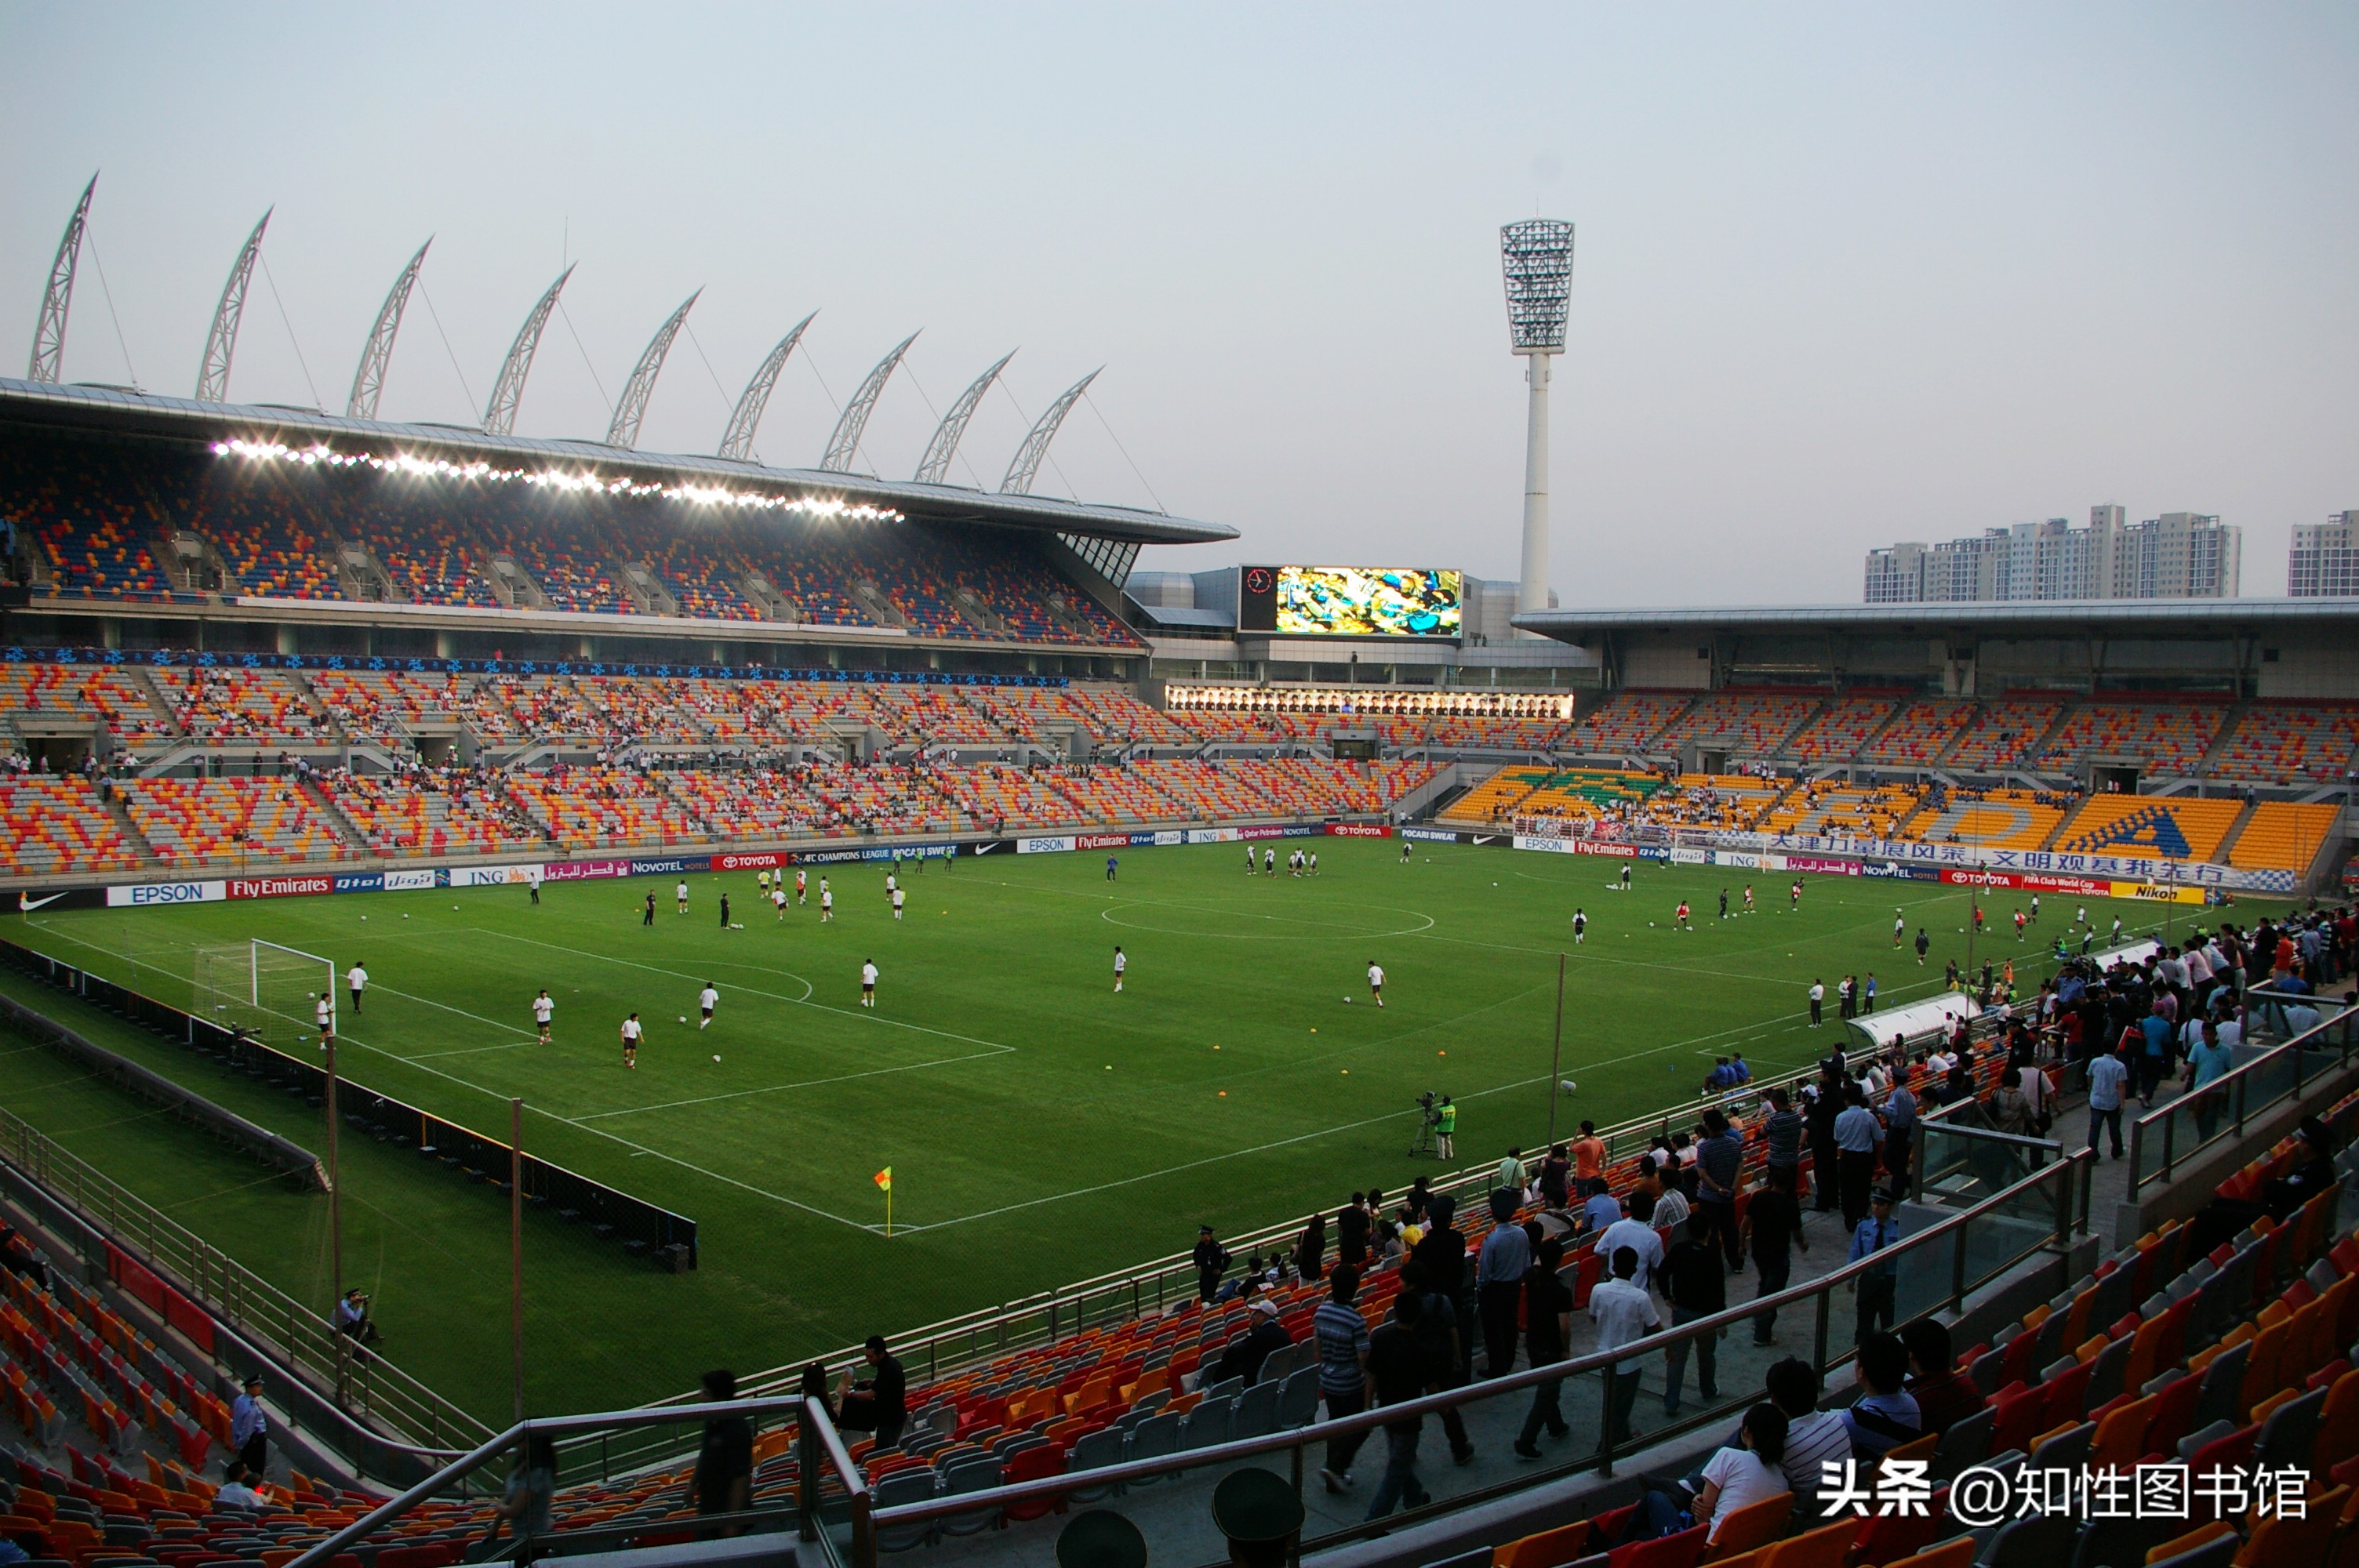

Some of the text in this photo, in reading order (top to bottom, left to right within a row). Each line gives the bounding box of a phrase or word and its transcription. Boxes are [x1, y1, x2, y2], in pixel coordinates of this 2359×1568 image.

[1199, 832, 1217, 842] ING
[1244, 830, 1259, 839] Qatar
[1283, 826, 1311, 836] NOVOTEL
[1348, 827, 1382, 836] TOYOTA
[1402, 829, 1457, 841] POCARI SWEAT
[1029, 839, 1064, 851] EPSON
[1078, 835, 1127, 849] Fly Emirates
[1525, 839, 1563, 851] EPSON
[1578, 841, 1634, 856] Fly Emirates
[1639, 848, 1669, 857] Qtl
[738, 855, 777, 866] TOYOTA
[803, 849, 889, 862] AFC CHAMPIONS LEAGUE
[1730, 855, 1755, 867] ING
[632, 861, 684, 873] NOVOTEL
[1863, 865, 1911, 878] NOVTEL
[336, 877, 383, 889] Qtel
[471, 870, 503, 885] ING
[1968, 873, 2010, 886] TOYOTA
[2024, 875, 2095, 890] FIFA Club World Cup
[132, 884, 202, 903] EPSON
[233, 878, 329, 898] Fly Emirates
[2135, 886, 2178, 900] Nikon
